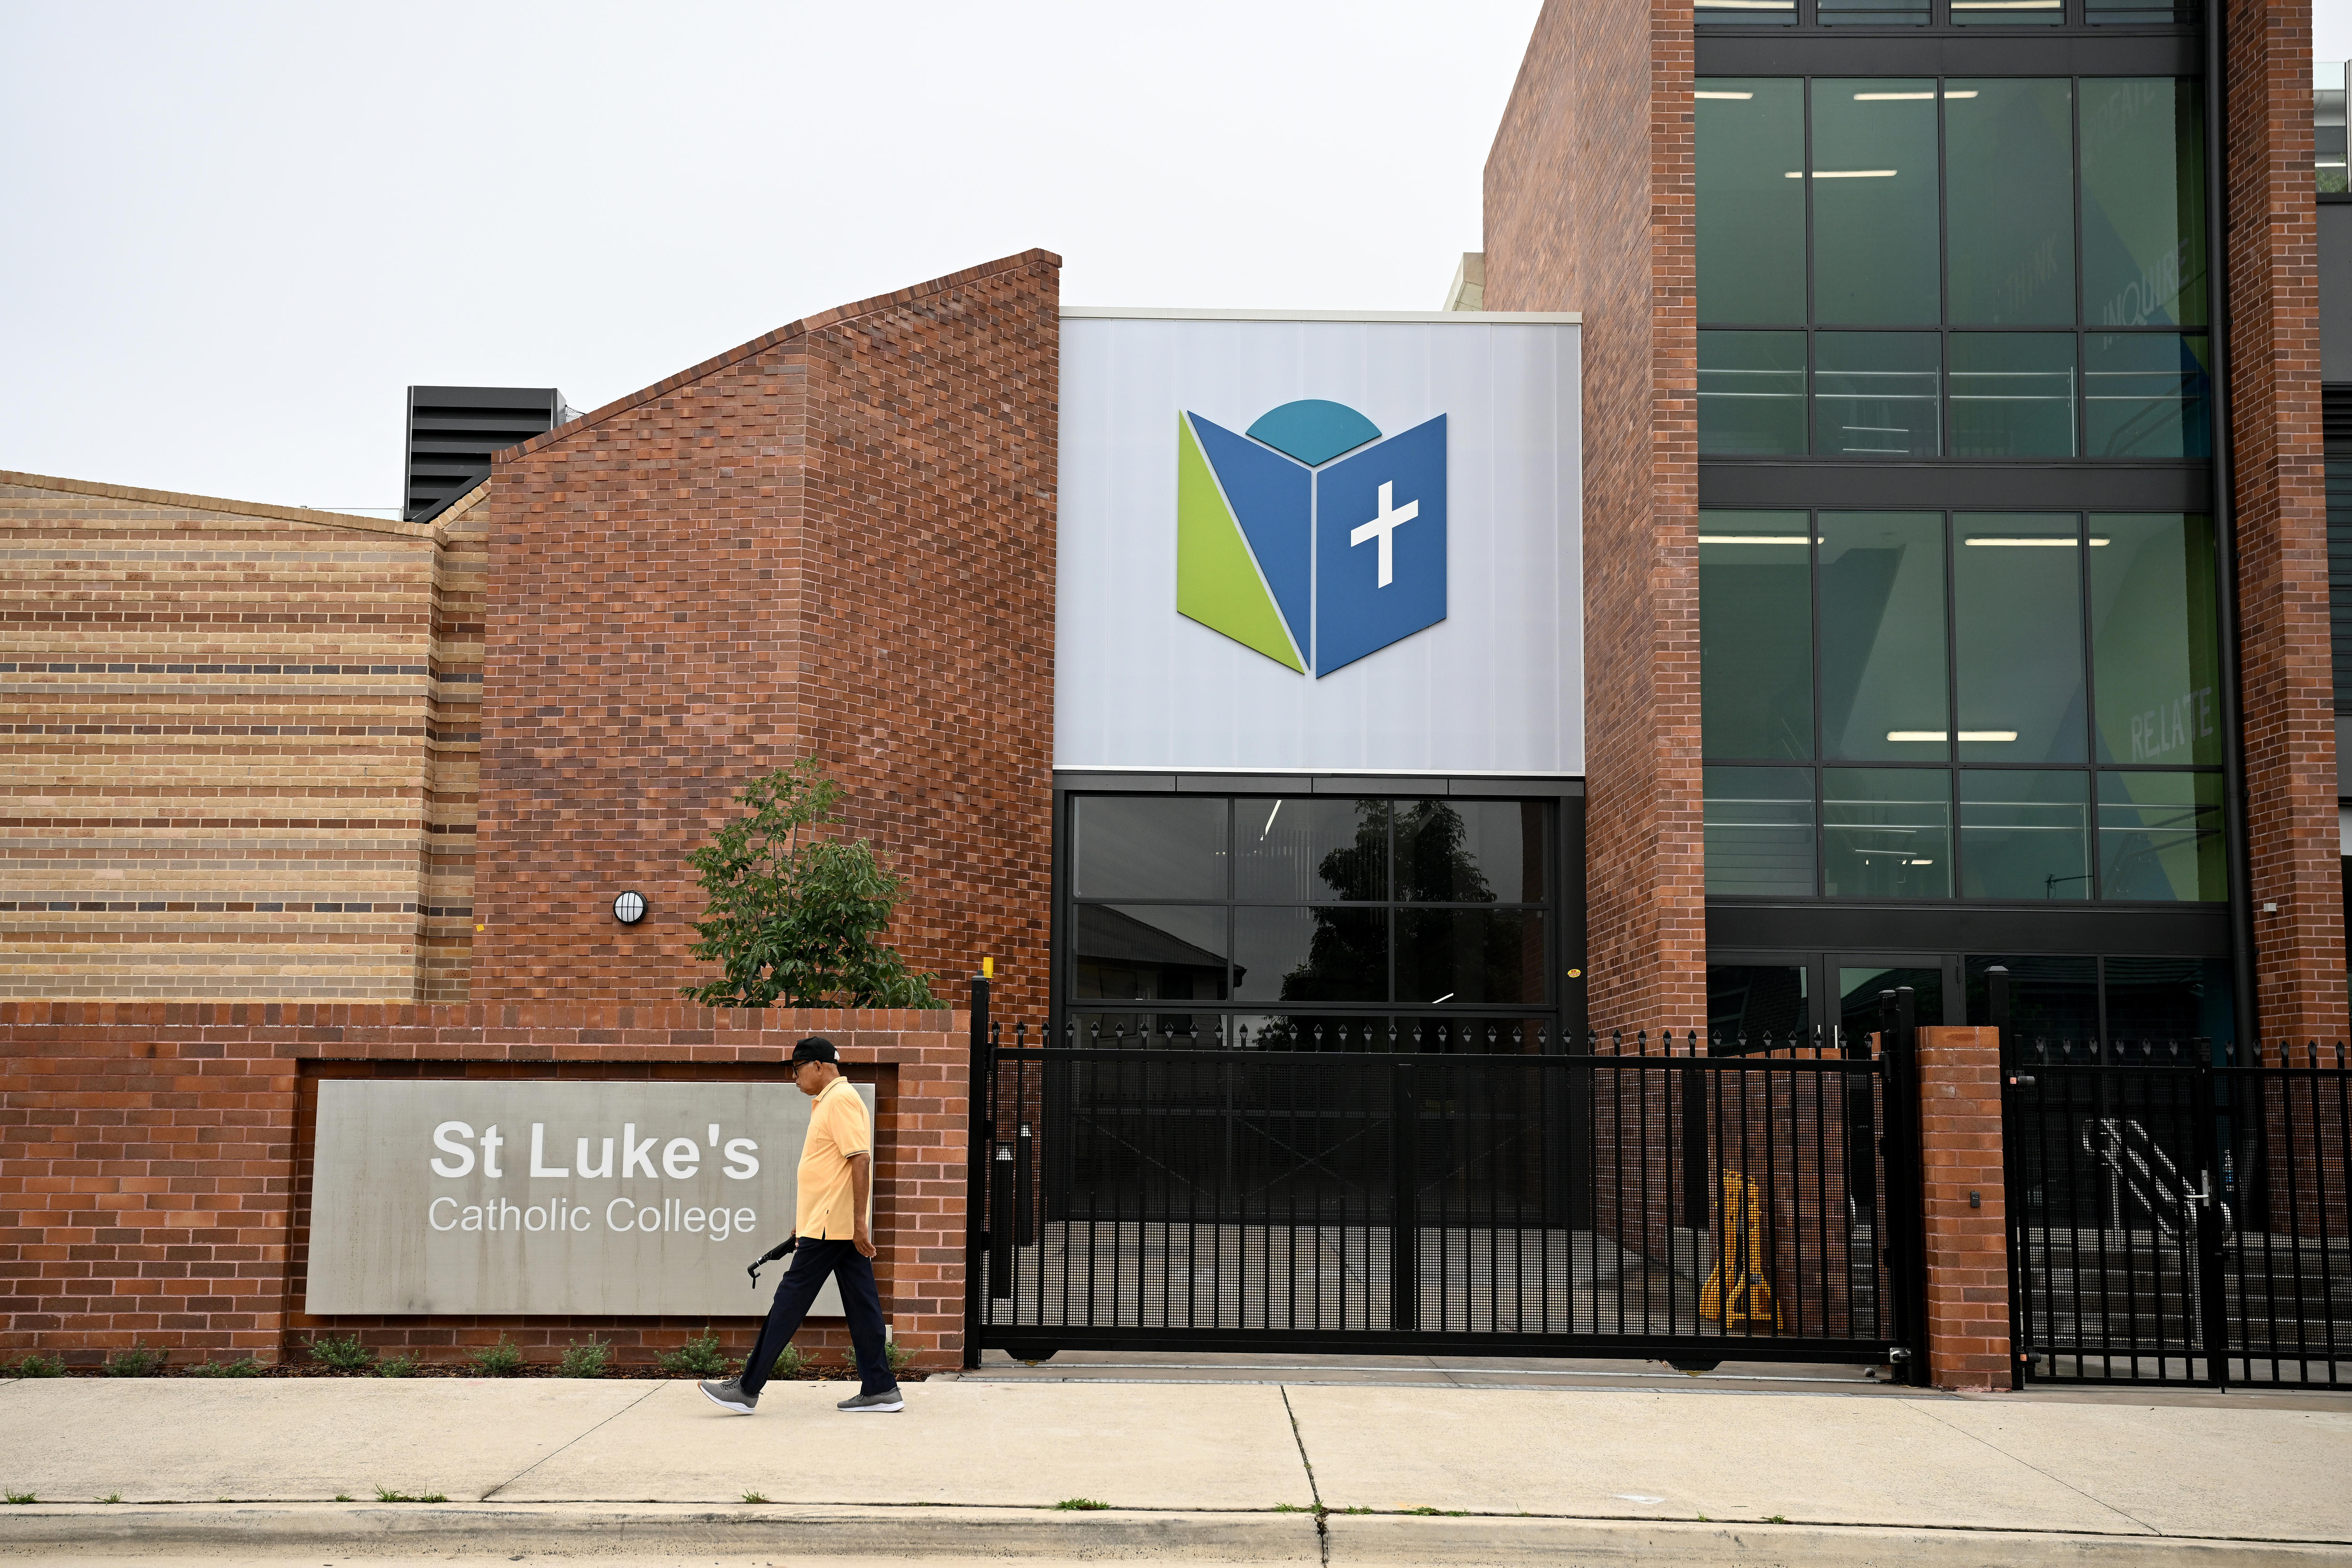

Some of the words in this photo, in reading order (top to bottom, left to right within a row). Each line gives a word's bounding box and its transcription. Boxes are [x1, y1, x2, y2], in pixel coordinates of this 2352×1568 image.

[2103, 236, 2189, 350] INQUIRE
[2131, 686, 2213, 763] RELATE
[430, 1120, 503, 1178] St
[530, 1122, 760, 1180] Luke's
[429, 1196, 591, 1232] Catholic
[605, 1197, 756, 1242] College
